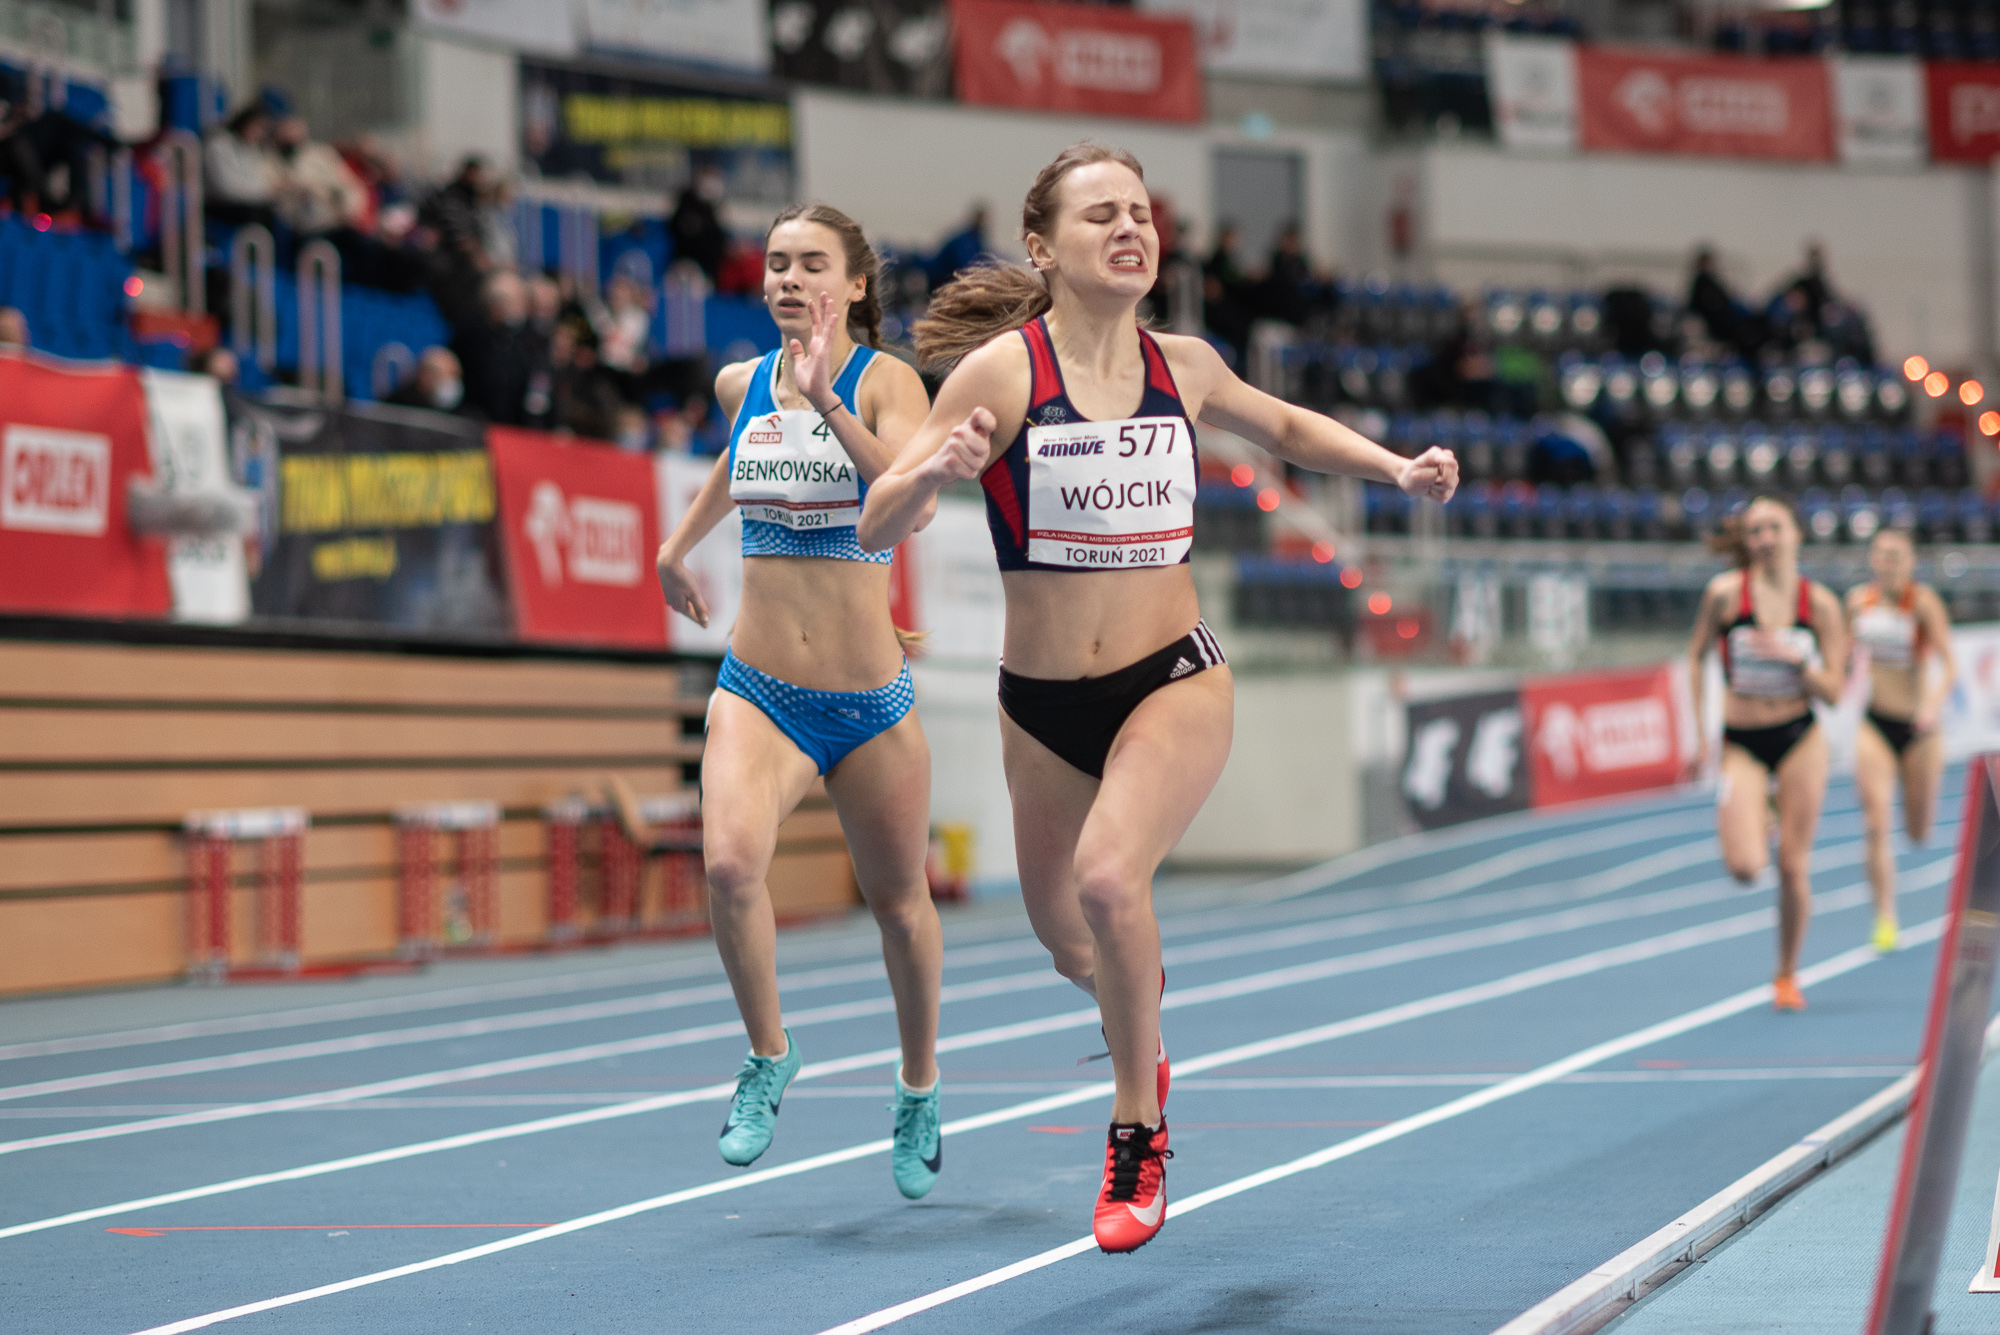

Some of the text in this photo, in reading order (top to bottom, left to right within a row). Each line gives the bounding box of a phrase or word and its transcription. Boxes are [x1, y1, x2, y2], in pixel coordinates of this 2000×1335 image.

[750, 433, 781, 443] ORLEN
[1118, 423, 1176, 458] 577
[736, 460, 852, 483] BENKOWSKA
[1060, 478, 1173, 511] WÓJCIK
[763, 508, 829, 526] TORUŃ 2021
[1089, 535, 1141, 543] MISTRZOSTWA
[1065, 546, 1166, 564] TORUŃ 2021
[1170, 663, 1196, 679] adidas
